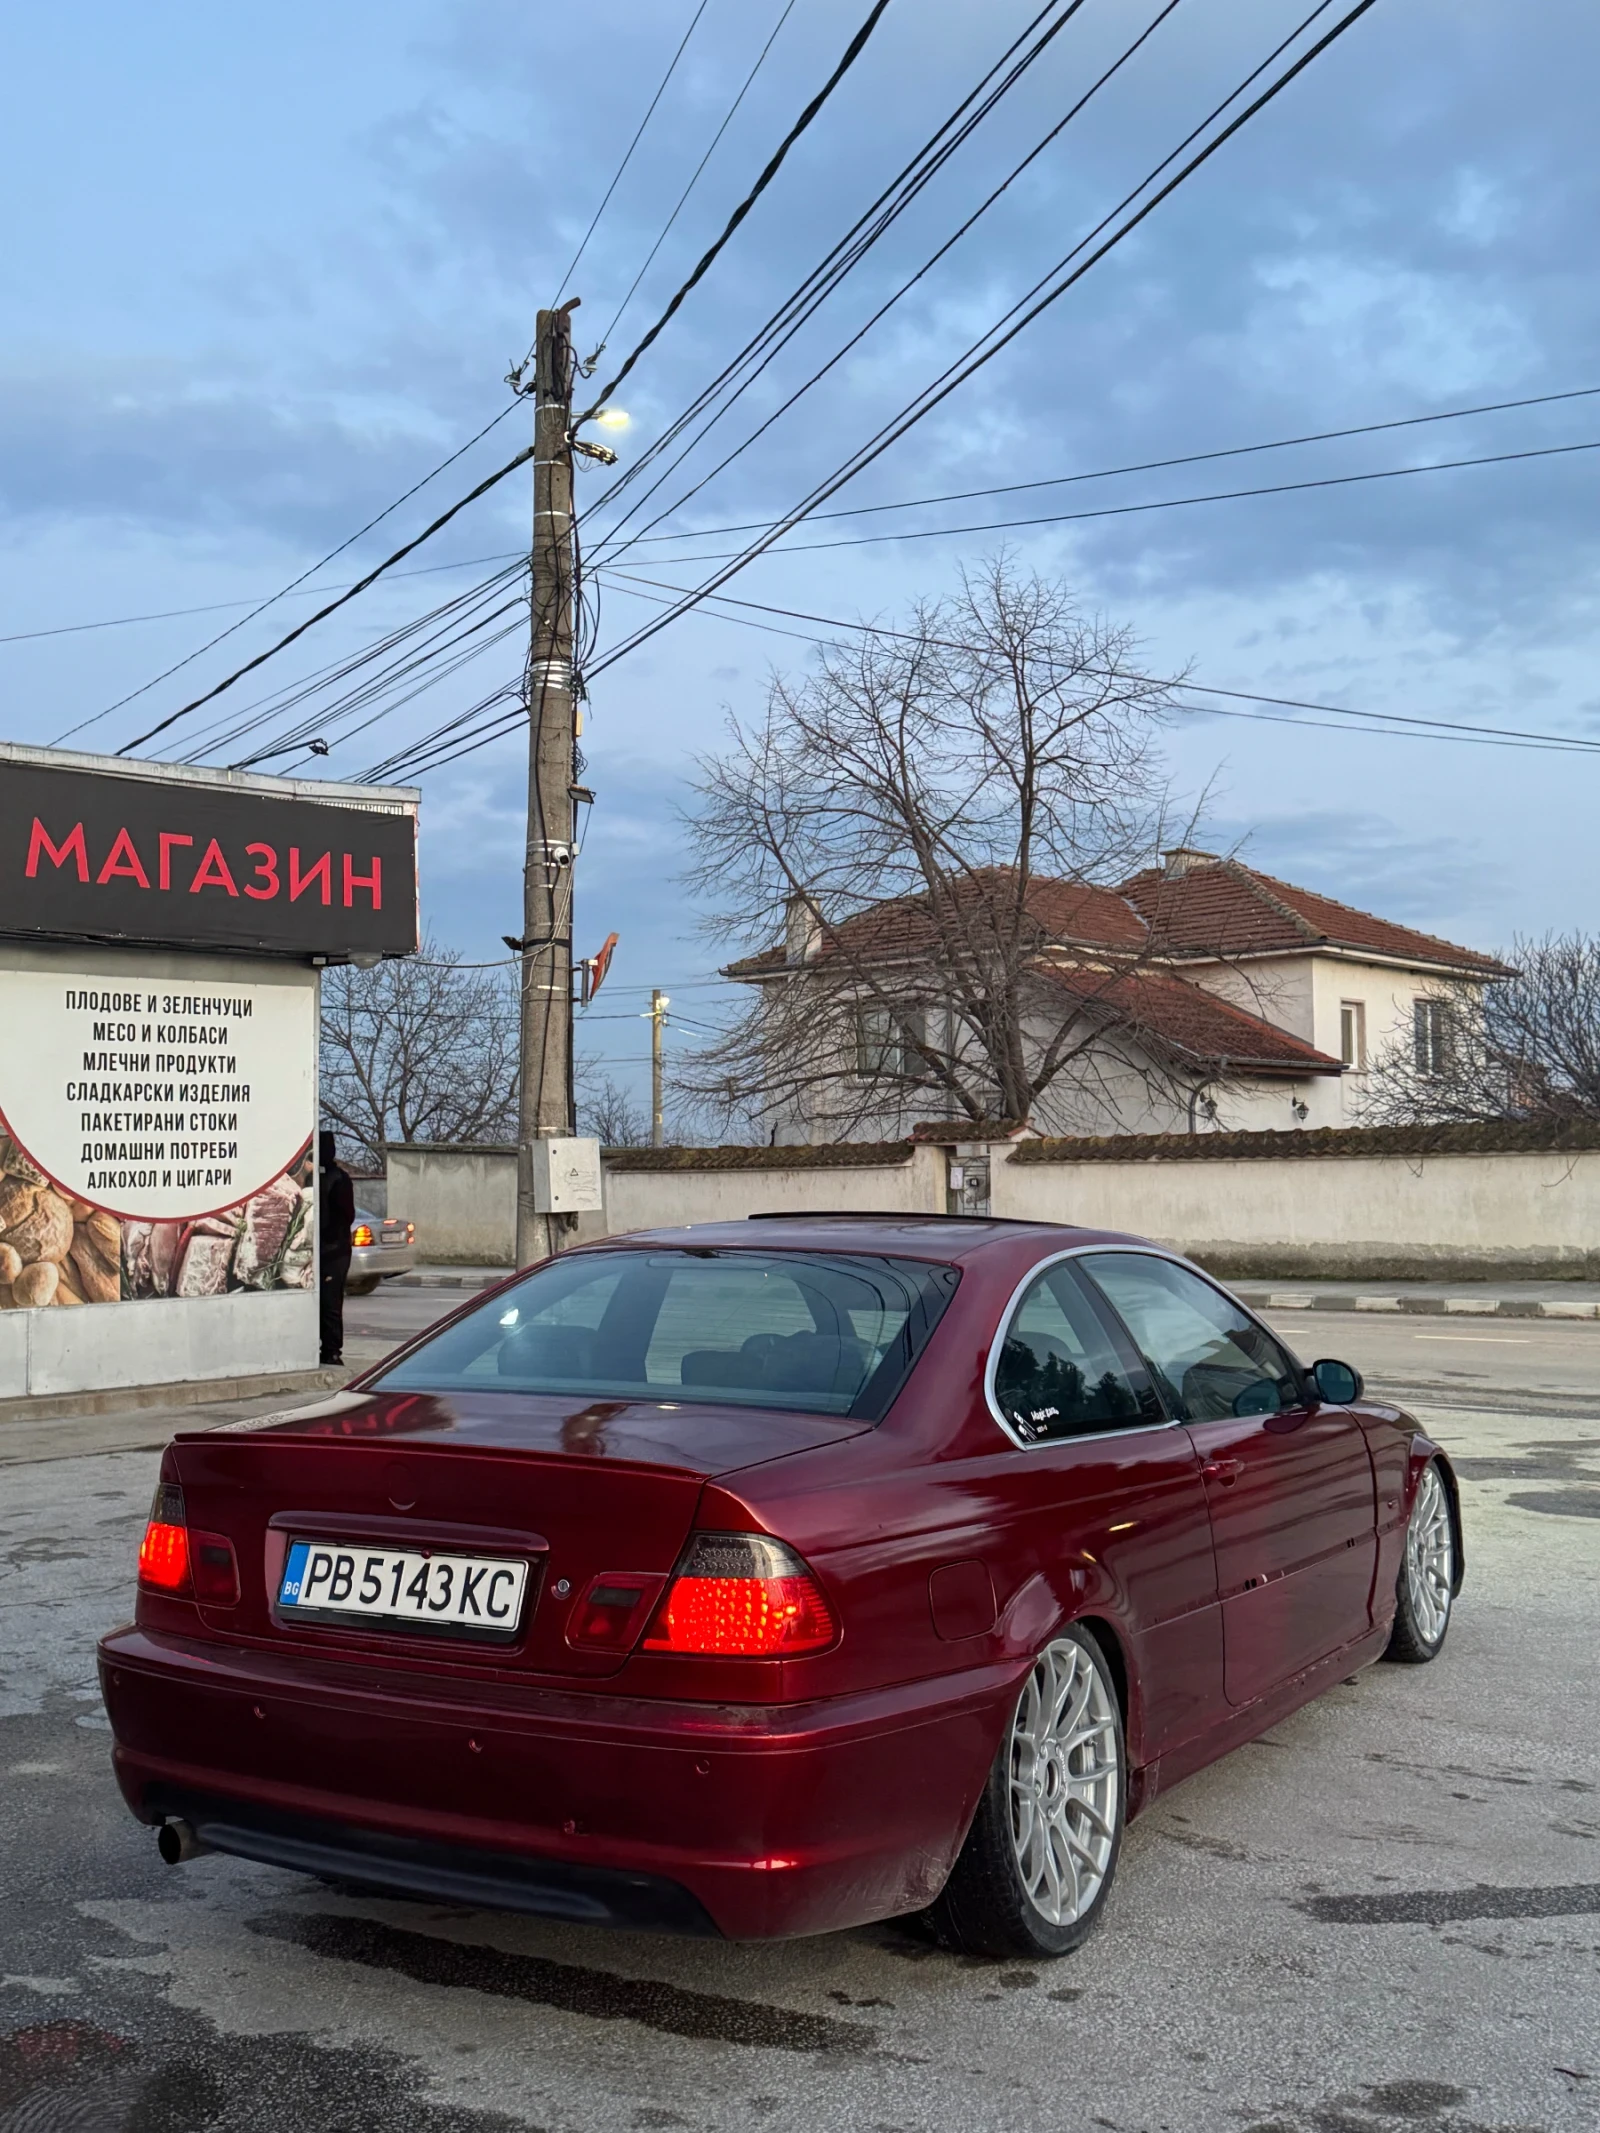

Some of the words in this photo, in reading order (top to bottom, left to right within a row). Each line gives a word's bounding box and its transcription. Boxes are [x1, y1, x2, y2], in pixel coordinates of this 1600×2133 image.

[25, 816, 382, 910] МАГАЗИН
[66, 990, 142, 1014] ПЛОДОВЕ
[147, 994, 157, 1013] И
[162, 995, 252, 1019] ЗЕЛЕНЧУЦИ
[93, 1022, 136, 1042] МЕСО
[141, 1024, 151, 1043] И
[157, 1024, 228, 1045] КОЛБАСИ
[83, 1051, 150, 1072] МЛЕЧНИ
[156, 1054, 236, 1075] ПРОДУКТИ
[66, 1082, 174, 1104] СЛАДКАРСКИ
[179, 1083, 250, 1105] ИЗДЕЛИЯ
[81, 1112, 185, 1132] ПАКЕТИРАНИ
[189, 1112, 237, 1131] СТОКИ
[80, 1142, 165, 1164] ДОМАШНИ
[170, 1141, 237, 1160] ПОТРЕБИ
[87, 1170, 157, 1189] АЛКОХОЛ
[162, 1170, 172, 1187] И
[176, 1168, 232, 1189] ЦИГАРИ
[284, 1581, 300, 1596] BG
